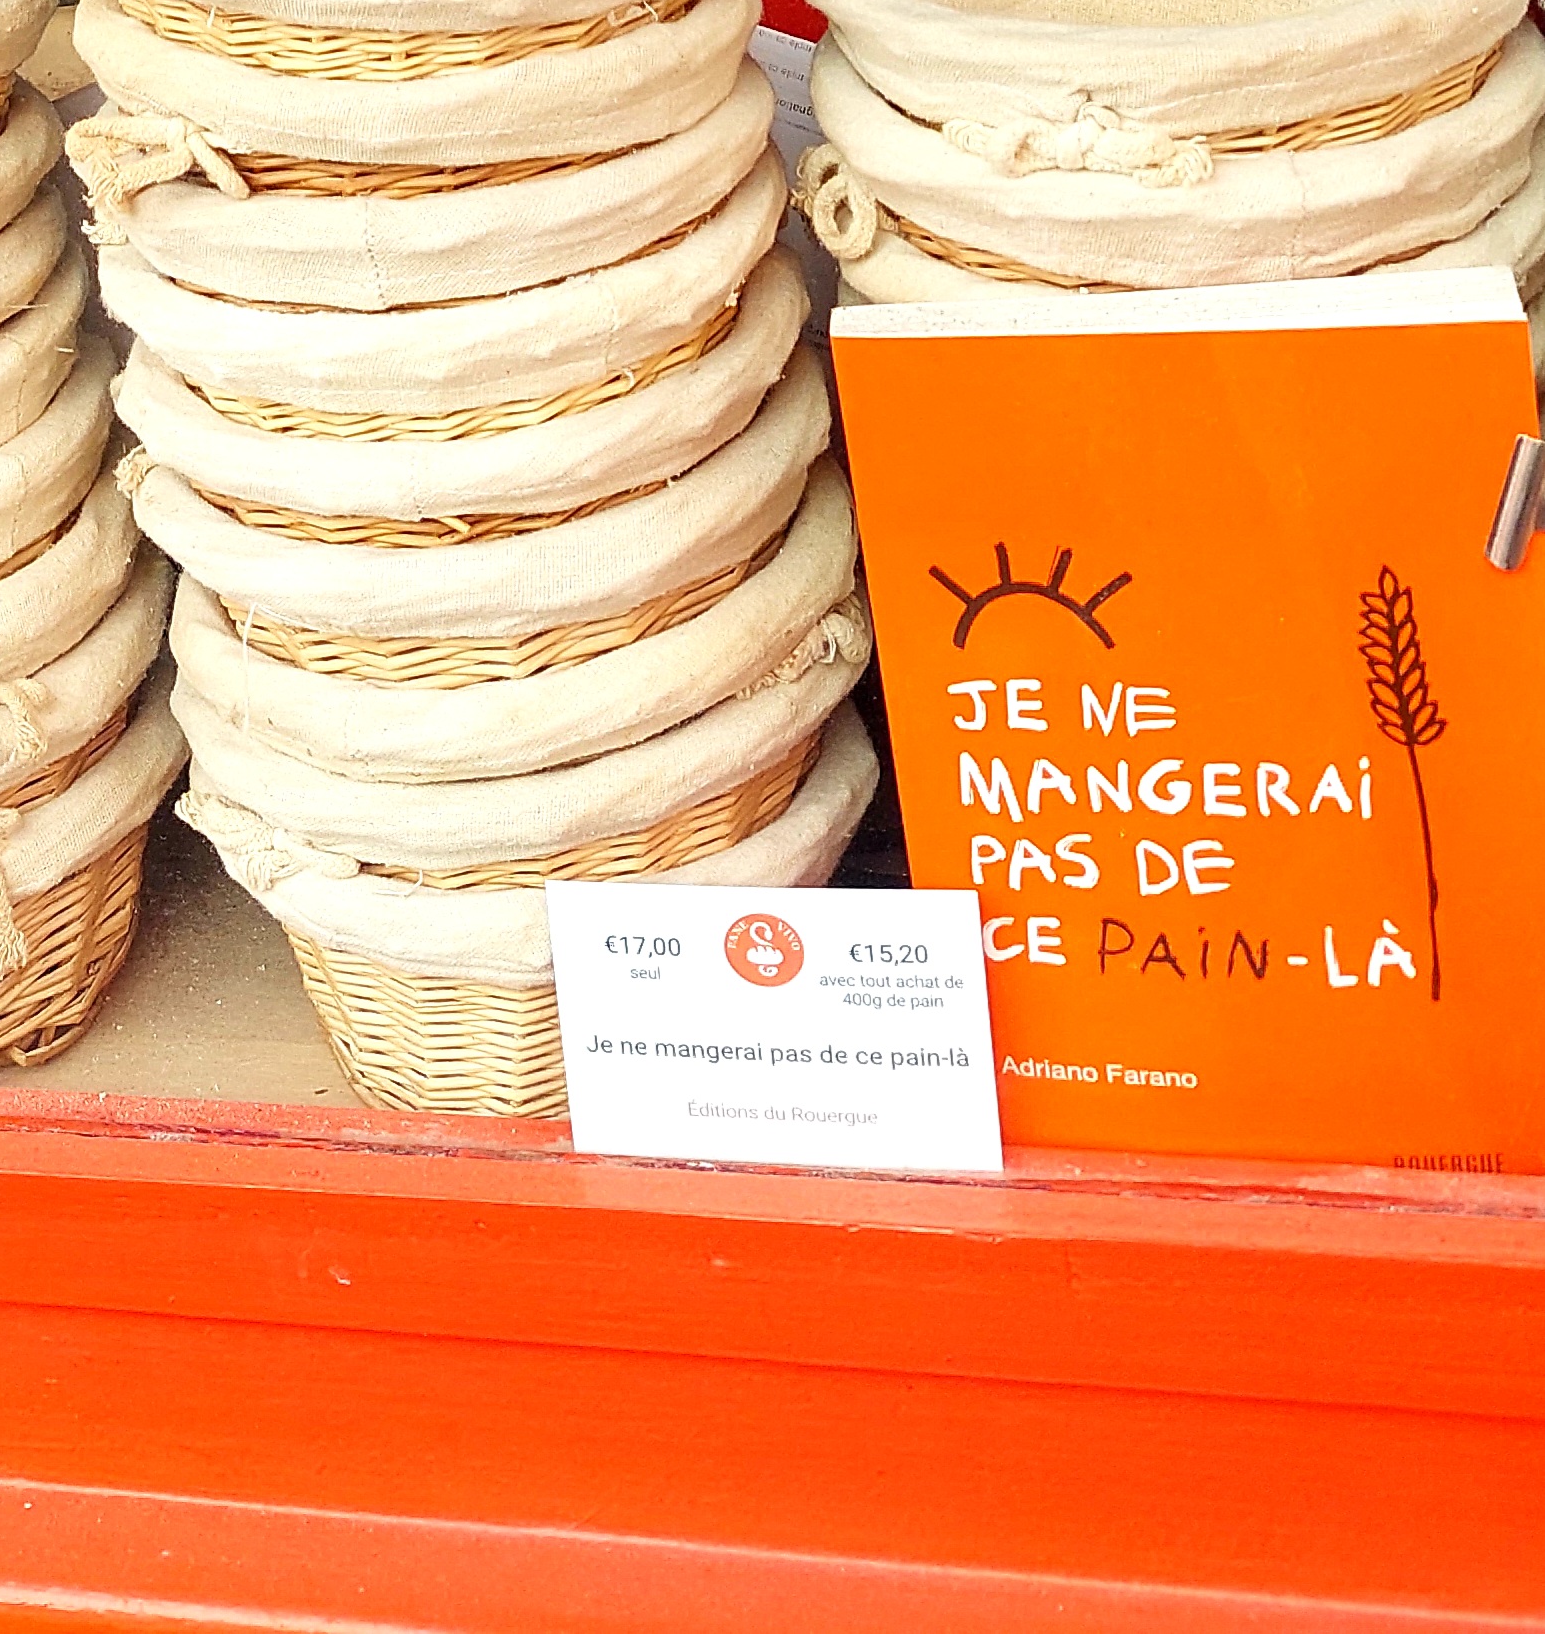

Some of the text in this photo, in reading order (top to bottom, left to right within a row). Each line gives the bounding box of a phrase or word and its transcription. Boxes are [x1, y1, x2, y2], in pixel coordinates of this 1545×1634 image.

[947, 679, 1178, 737] JE NE
[970, 833, 1235, 896] PAS DE
[604, 934, 682, 959] €17,00
[848, 943, 929, 967] €15,20
[982, 916, 1067, 966] CE
[630, 967, 662, 980] seul
[819, 975, 965, 990] avec tout achat de
[842, 992, 945, 1011] 400g de pain
[586, 1035, 970, 1071] Je ne mangerai pas de ce pain-là
[1003, 1055, 1198, 1088] Adriano Farano
[687, 1098, 879, 1128] Éditions du Rouergue
